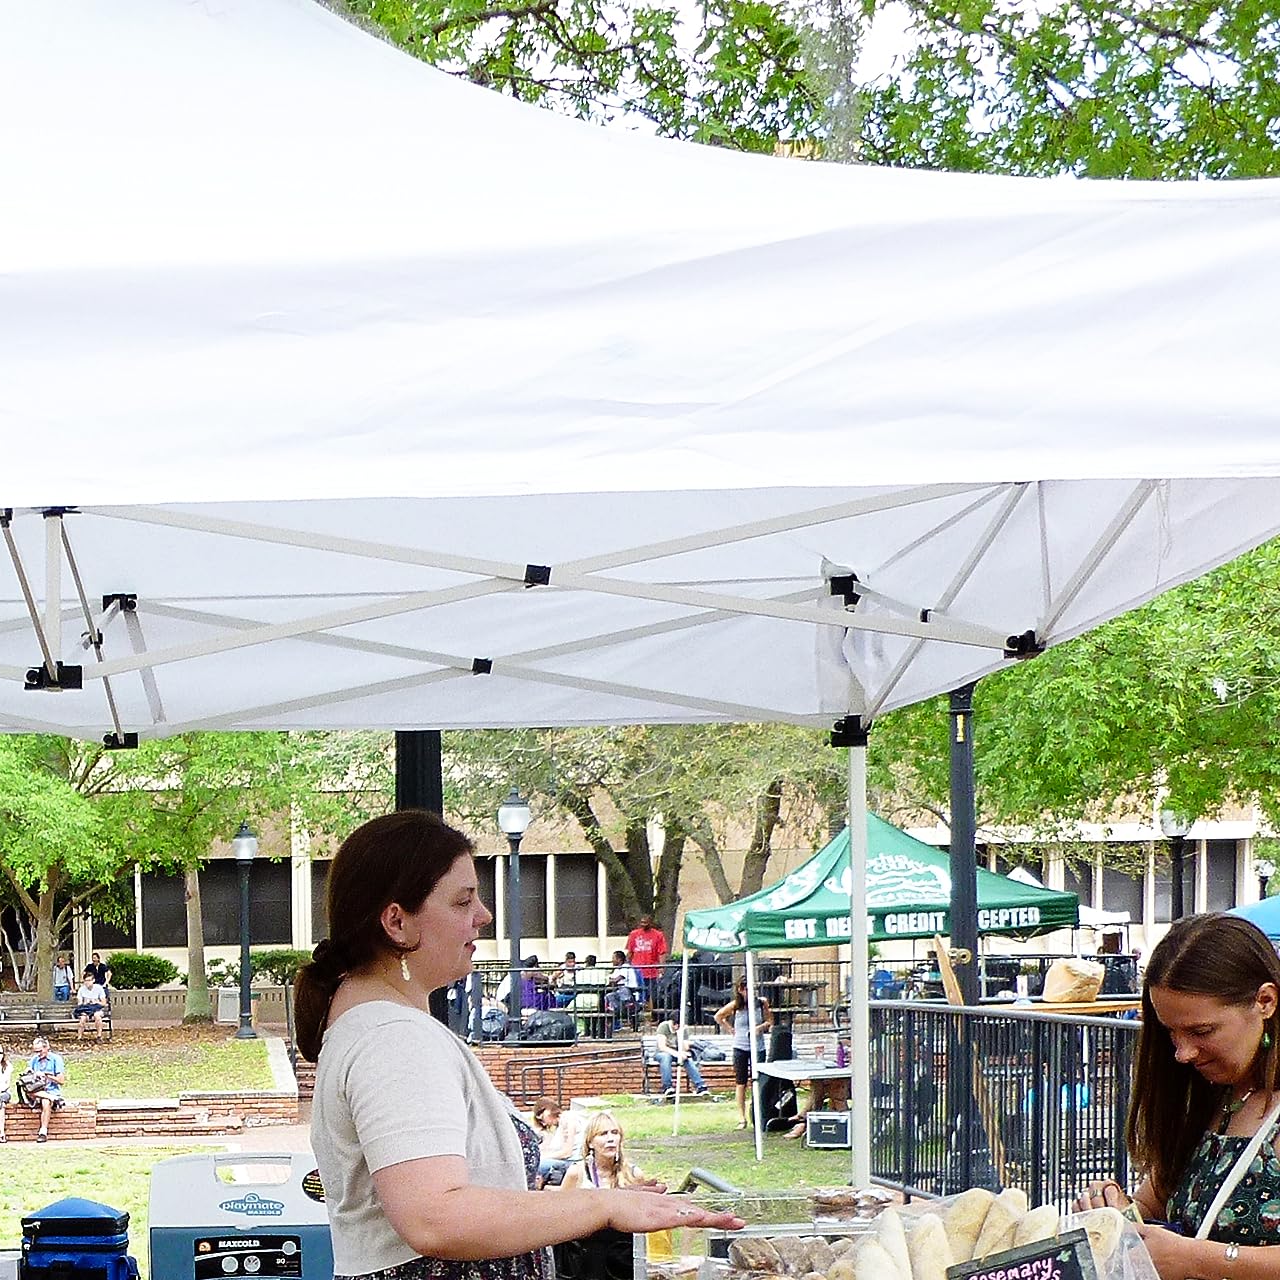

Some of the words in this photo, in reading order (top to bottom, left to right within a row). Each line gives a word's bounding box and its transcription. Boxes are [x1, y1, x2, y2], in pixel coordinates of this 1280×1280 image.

[884, 912, 946, 935] CREDIT
[222, 1201, 284, 1212] playmate
[218, 1239, 260, 1248] MAXCOLD
